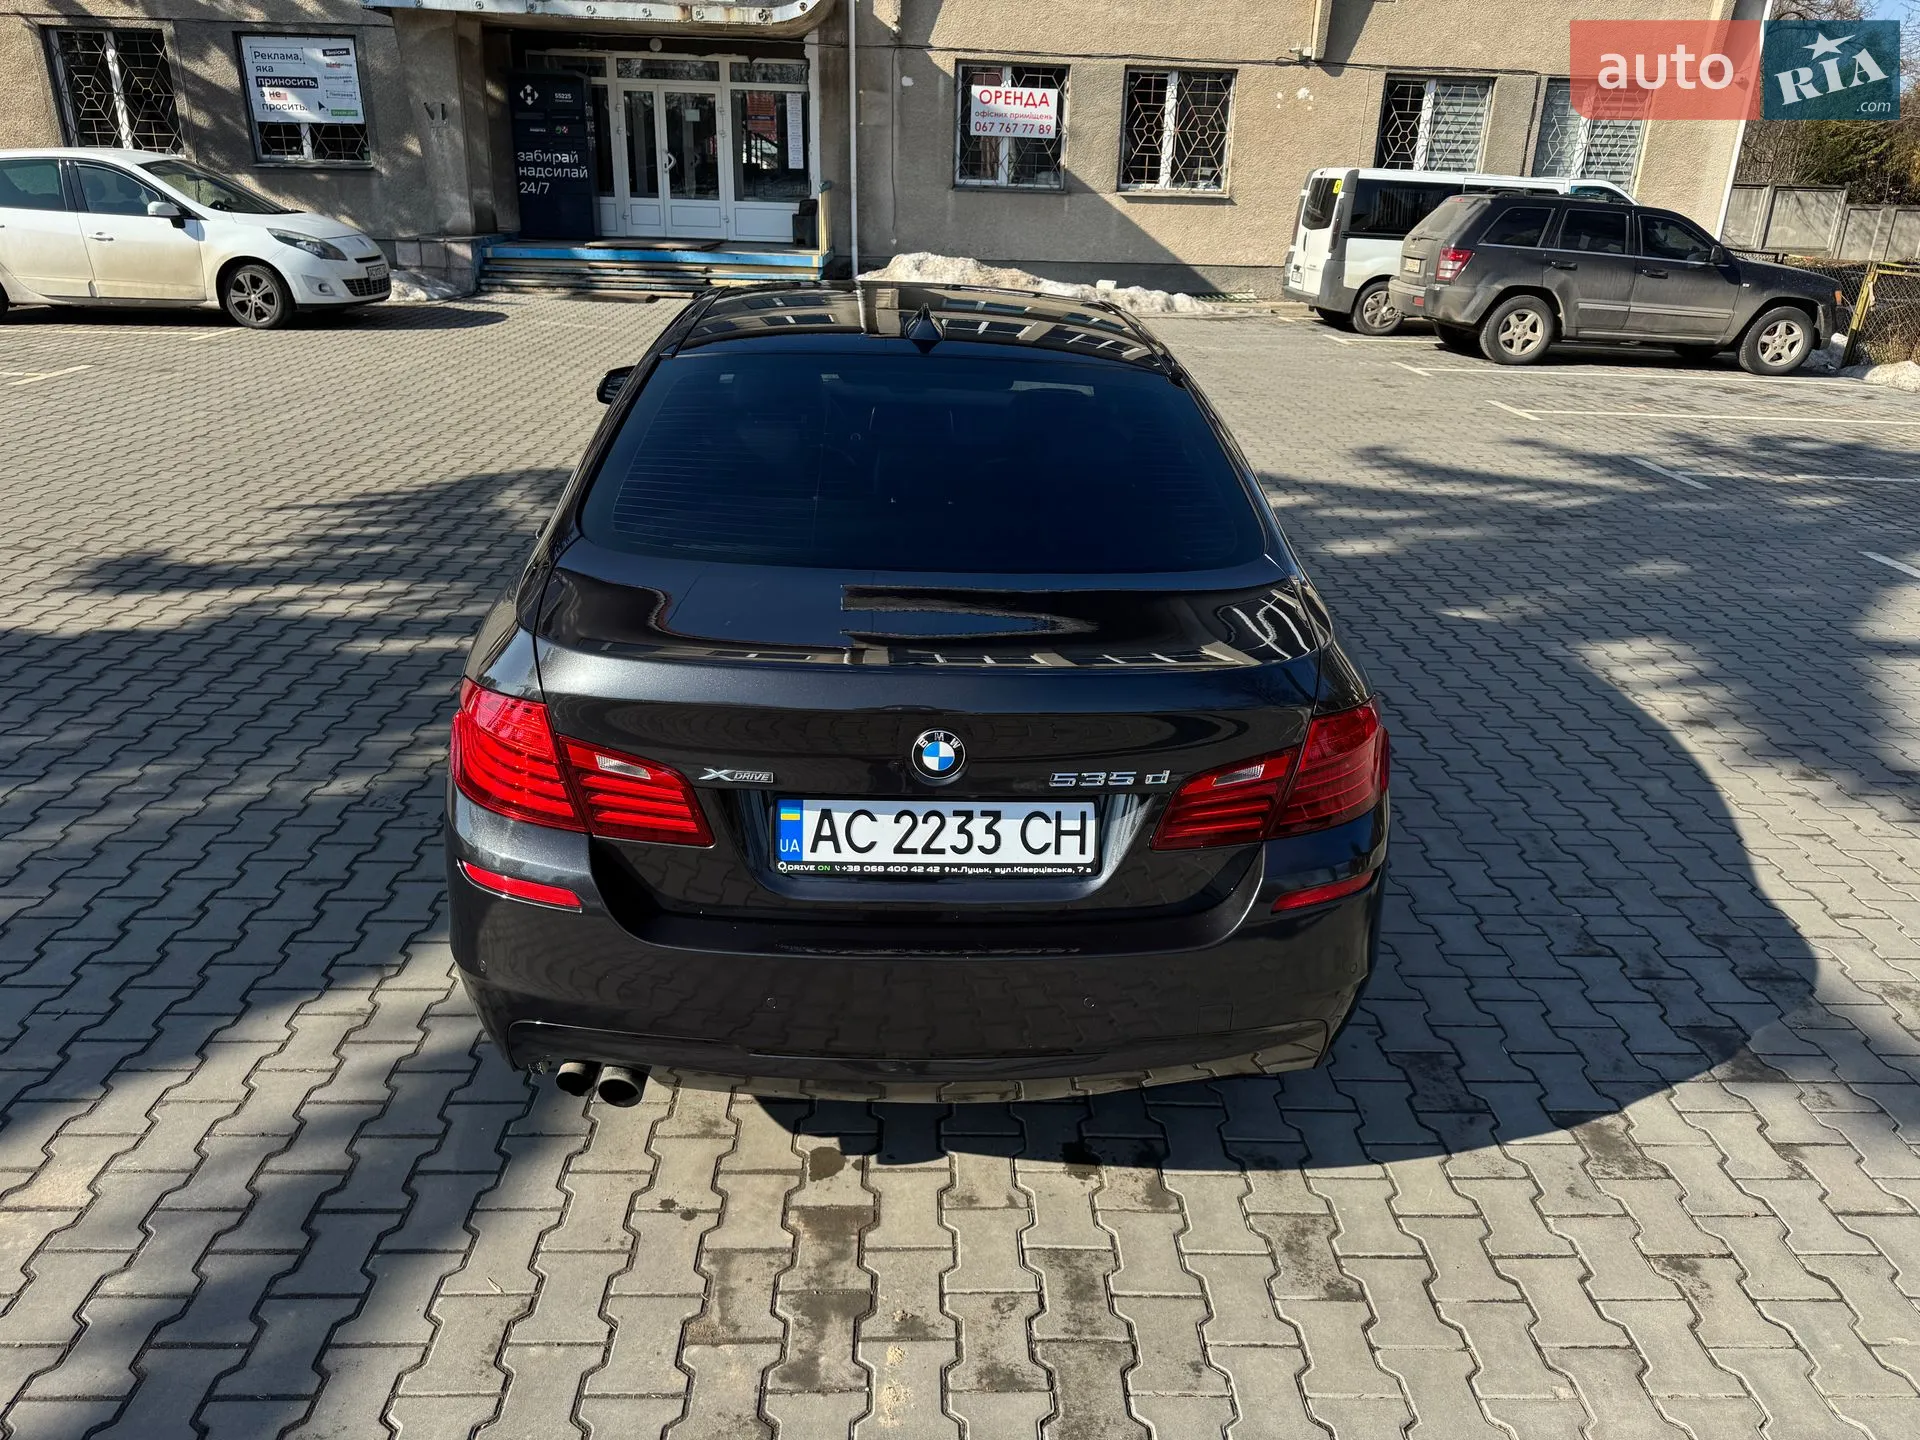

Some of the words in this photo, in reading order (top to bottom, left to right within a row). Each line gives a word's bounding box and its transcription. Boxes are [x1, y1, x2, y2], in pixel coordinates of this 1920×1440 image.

[253, 50, 302, 61] Реклама,
[255, 65, 274, 73] яка
[257, 77, 318, 88] приносить,
[268, 90, 281, 98] не
[979, 89, 1050, 108] ОРЕНДА
[262, 103, 308, 112] просить.
[975, 110, 1008, 118] офісних
[1009, 112, 1053, 120] приміщень
[974, 121, 995, 132] 067
[999, 122, 1019, 133] 767
[1022, 124, 1035, 134] 77
[1038, 124, 1052, 134] 89
[517, 150, 579, 165] забирай
[519, 166, 588, 178] надсилай
[520, 182, 550, 194] 24/7
[1049, 771, 1137, 787] 535
[1144, 769, 1171, 785] d
[809, 808, 878, 854] AC
[893, 809, 1002, 855] 2233
[1020, 810, 1087, 855] CH
[779, 839, 801, 853] UA
[886, 865, 909, 873] 400
[910, 865, 925, 873] 42
[926, 865, 941, 873] 42
